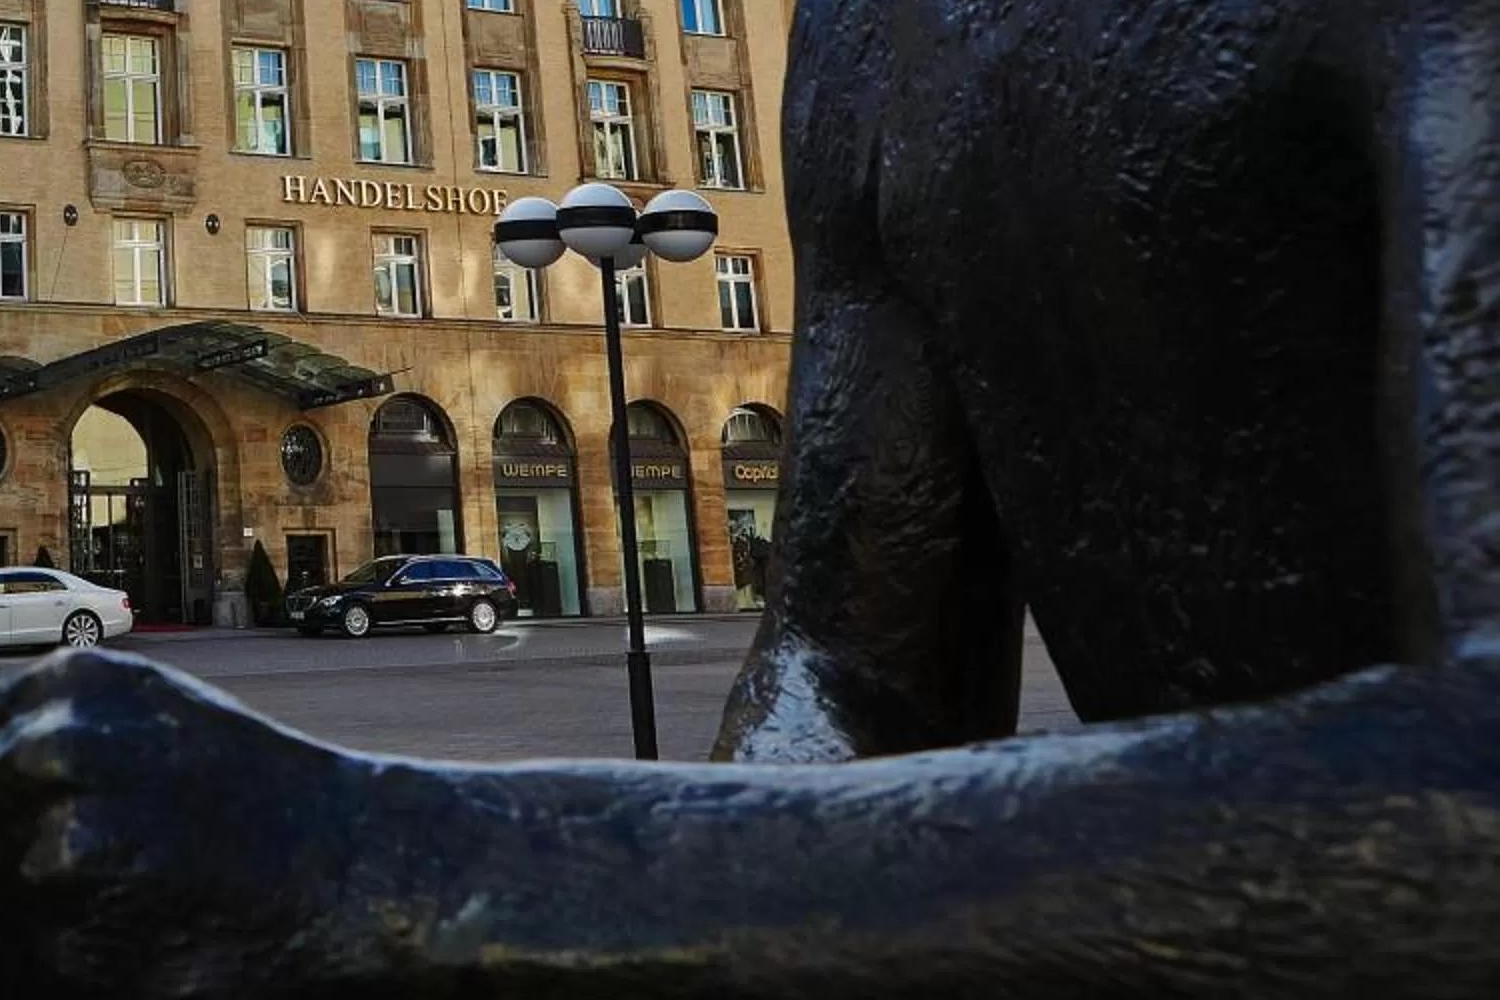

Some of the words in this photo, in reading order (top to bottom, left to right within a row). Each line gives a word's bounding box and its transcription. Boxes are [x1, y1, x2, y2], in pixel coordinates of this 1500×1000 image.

[283, 175, 508, 216] HANDELSHOF
[502, 463, 568, 477] WEMPE
[631, 465, 684, 479] EMPE
